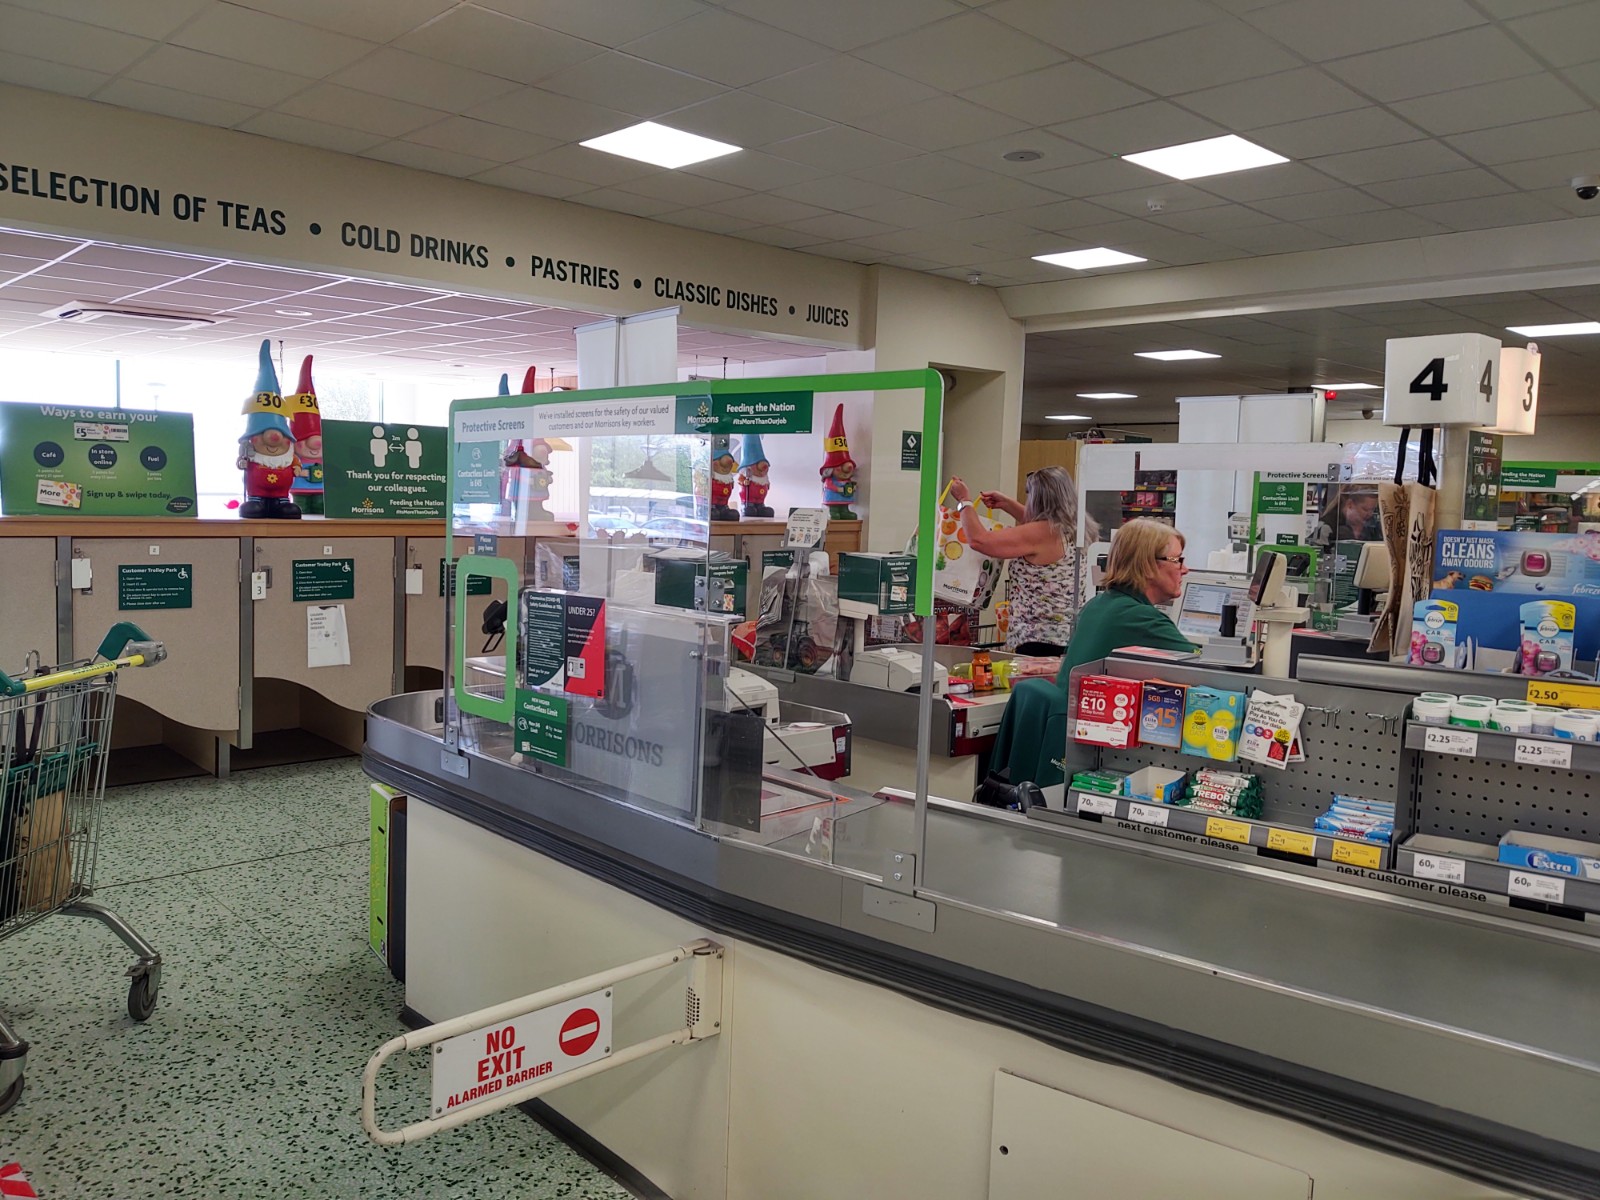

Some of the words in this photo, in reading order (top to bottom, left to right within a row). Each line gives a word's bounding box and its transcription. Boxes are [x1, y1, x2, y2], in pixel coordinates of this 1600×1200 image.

[174, 193, 206, 223] OF
[217, 200, 286, 236] TEAS
[342, 222, 400, 254] COLD
[410, 233, 489, 268] DRINKS
[531, 255, 620, 290] PASTRIES
[654, 276, 721, 306] CLASSIC
[726, 290, 778, 316] DISHES
[806, 304, 849, 328] JUICES
[1409, 357, 1448, 401] 4
[1479, 359, 1493, 402] 4
[1522, 371, 1534, 412] 3
[256, 393, 282, 408] £30
[40, 405, 76, 420] Ways
[80, 408, 94, 419] to
[98, 410, 126, 420] earn
[130, 412, 158, 424] your
[553, 409, 575, 419] installed
[575, 409, 594, 418] screens
[594, 407, 603, 417] for
[603, 407, 613, 416] the
[613, 405, 631, 417] safety
[631, 405, 637, 415] of
[638, 406, 649, 415] our
[649, 404, 669, 415] valued
[726, 404, 754, 415] Feeding
[755, 403, 765, 412] the
[769, 402, 795, 412] Nation
[462, 421, 497, 433] Protective
[498, 419, 525, 431] Screens
[574, 420, 585, 429] and
[585, 421, 594, 429] our
[594, 419, 621, 429] Morrisons
[621, 419, 632, 430] key
[687, 415, 719, 424] Morrisons
[1480, 436, 1492, 445] Please
[1473, 446, 1481, 454] pay
[346, 470, 372, 479] Thank
[374, 473, 390, 481] you
[391, 471, 404, 479] for
[405, 473, 446, 483] respecting
[40, 489, 61, 497] More
[86, 490, 104, 498] Sign
[108, 491, 115, 499] up
[126, 491, 147, 499] swipe
[149, 491, 172, 500] today.
[368, 484, 382, 492] our
[384, 483, 427, 494] colleagues.
[1442, 542, 1495, 560] CLEANS
[1441, 558, 1463, 567] AWAY
[1463, 560, 1493, 569] ODOURS
[257, 586, 262, 595] 3
[943, 583, 968, 594] Morrisons
[568, 606, 587, 615] UNDER
[587, 608, 595, 616] 25?
[1529, 689, 1558, 700] £2.50
[523, 702, 547, 714] Contactless
[546, 708, 558, 717] Limit
[1081, 696, 1106, 711] £10
[1249, 710, 1259, 718] Pay
[1250, 705, 1280, 717] Unbeatable
[574, 721, 664, 767] ORRISONS
[1427, 733, 1450, 744] £2.25
[1518, 745, 1542, 755] £2.25
[1081, 797, 1094, 807] 70p
[1193, 789, 1231, 803] TREBOR
[1132, 807, 1144, 816] 70p
[1117, 820, 1141, 832] next
[1143, 827, 1198, 844] customer
[1200, 837, 1239, 851] please
[1418, 858, 1435, 869] 60p
[1532, 855, 1572, 873] Extra
[1336, 864, 1366, 877] next
[1368, 871, 1436, 893] customer
[1438, 885, 1487, 902] please
[1514, 876, 1531, 888] 60p
[486, 1025, 515, 1055] NO
[477, 1046, 525, 1082] EXIT
[446, 1079, 502, 1108] ALARMED
[506, 1061, 553, 1087] BARRIER
